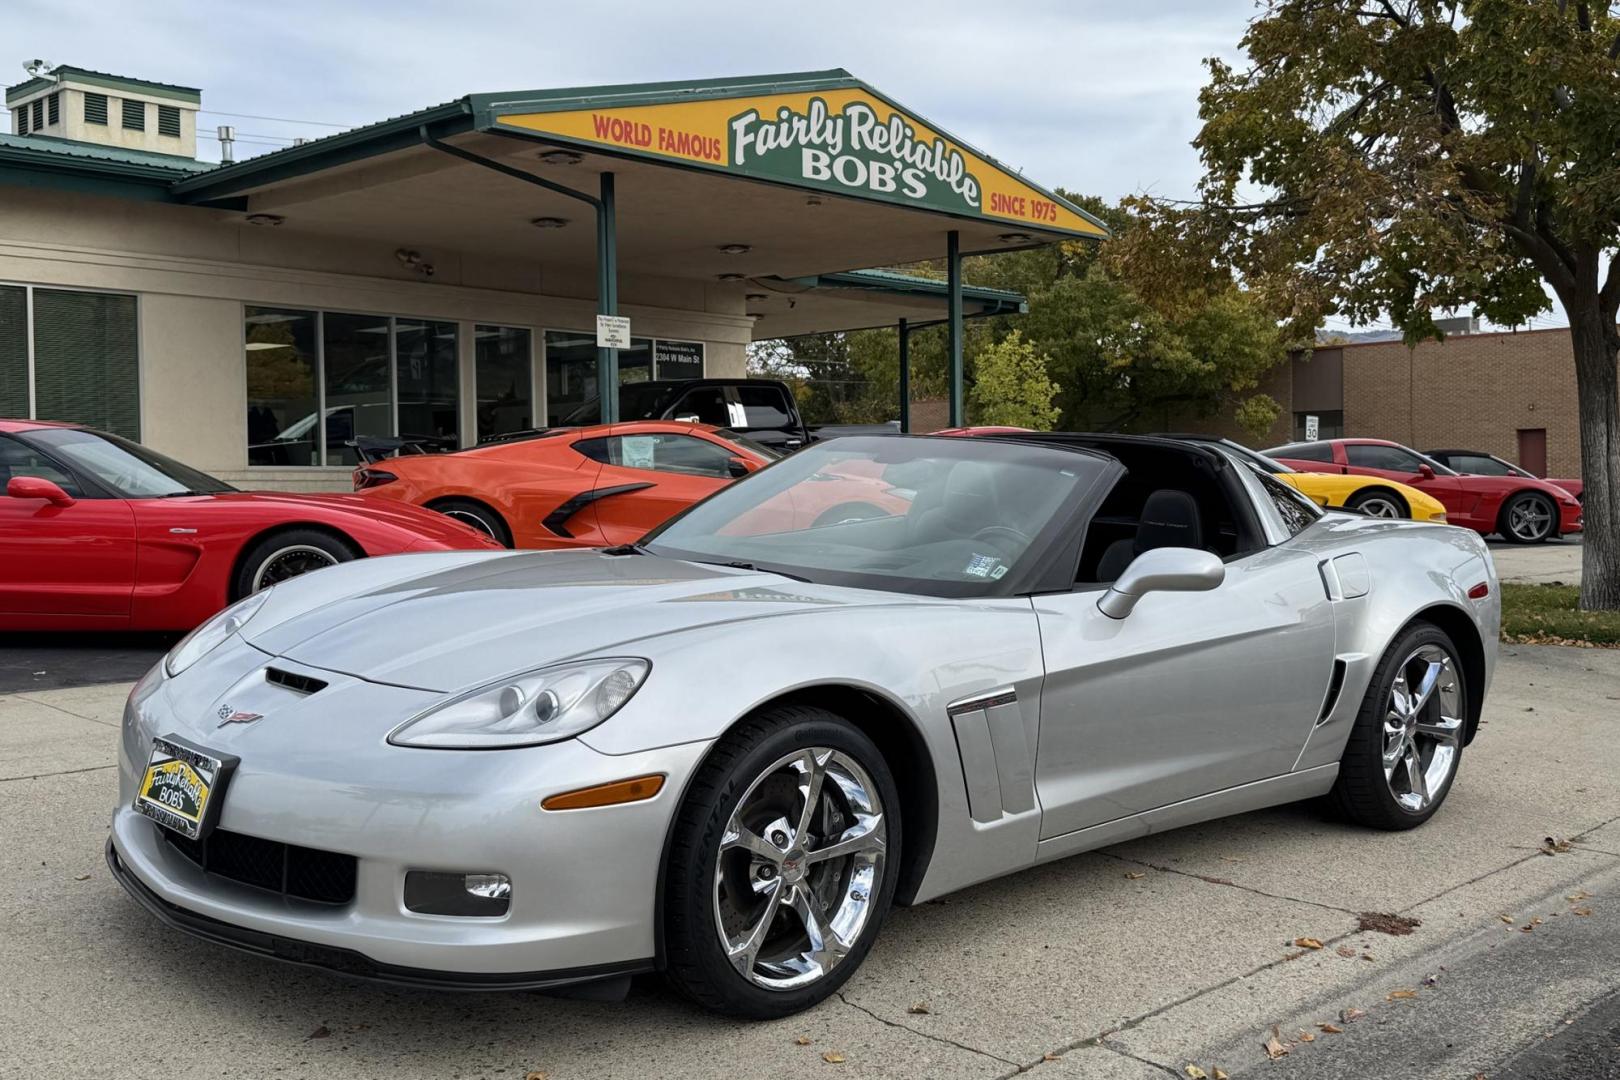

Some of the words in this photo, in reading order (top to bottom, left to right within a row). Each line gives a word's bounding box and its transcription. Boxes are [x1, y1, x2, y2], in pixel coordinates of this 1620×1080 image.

[592, 114, 652, 147] WORLD
[658, 127, 721, 161] FAMOUS
[732, 100, 843, 165] Fairly
[846, 104, 980, 207] Reliable
[801, 147, 927, 198] BOB'S
[990, 192, 1025, 216] SINCE
[1030, 199, 1057, 222] 1975
[678, 354, 692, 363] Main
[1307, 428, 1317, 438] 30
[158, 786, 186, 810] BOB'S
